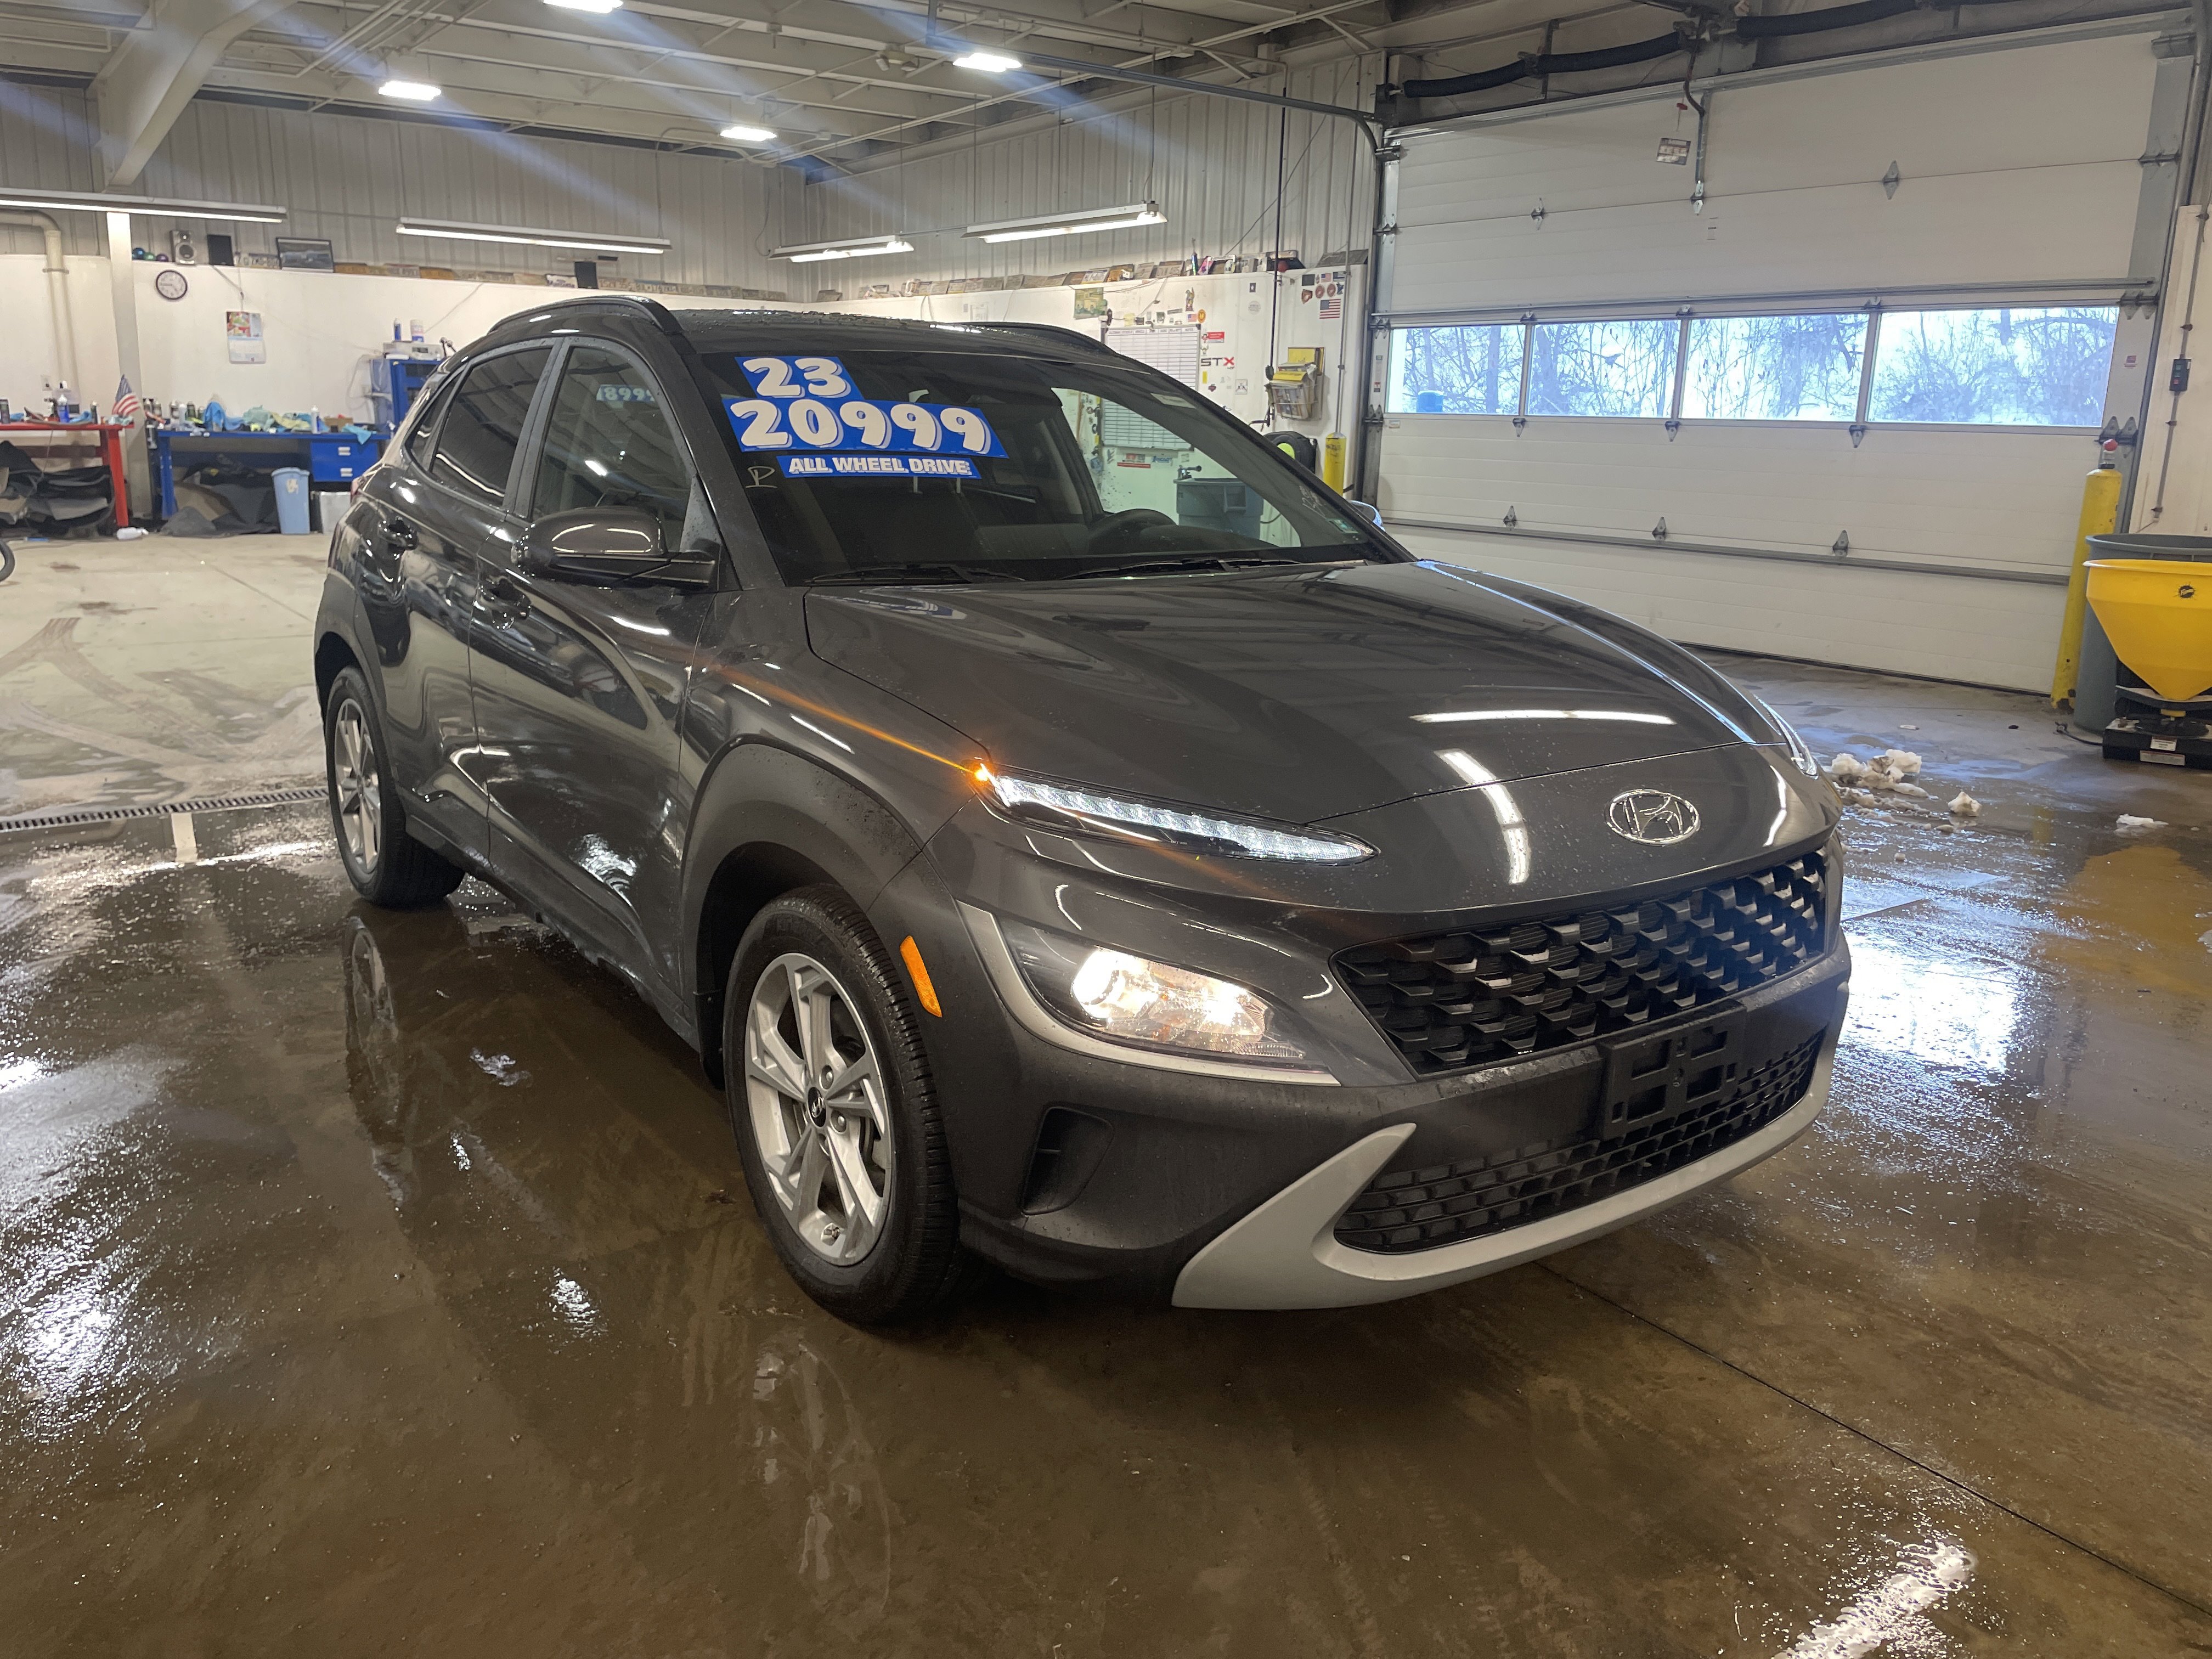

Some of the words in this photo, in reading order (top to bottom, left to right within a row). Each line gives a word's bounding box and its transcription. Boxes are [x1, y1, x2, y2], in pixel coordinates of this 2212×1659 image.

[1201, 357, 1234, 366] STX
[743, 358, 851, 398] 23
[730, 399, 991, 454] 20999
[789, 457, 833, 473] ALL
[832, 457, 909, 473] WHEEL
[909, 458, 972, 476] DRIVE
